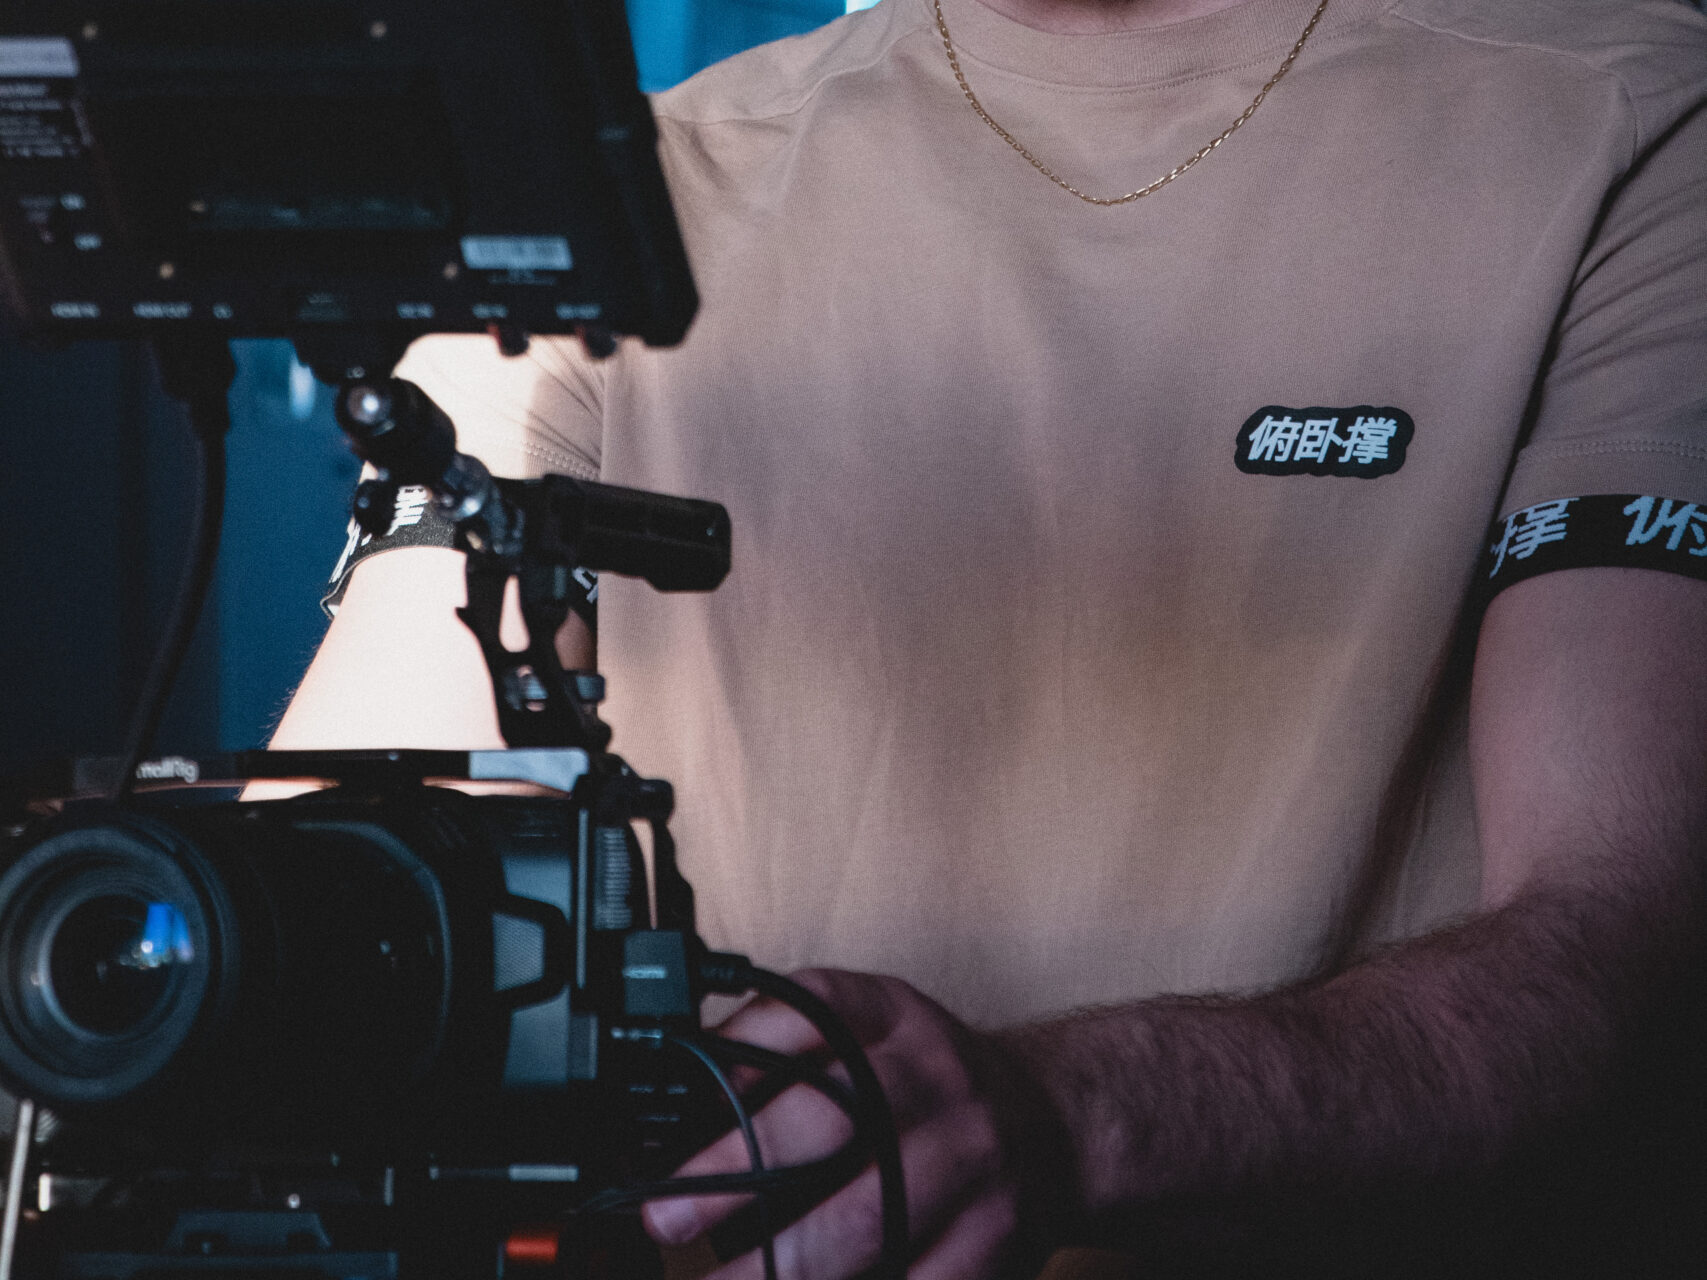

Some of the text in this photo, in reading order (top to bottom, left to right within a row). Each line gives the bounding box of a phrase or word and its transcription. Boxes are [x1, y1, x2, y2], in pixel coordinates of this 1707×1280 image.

[1248, 415, 1398, 464] 俯卧撑
[136, 756, 199, 784] mallRig
